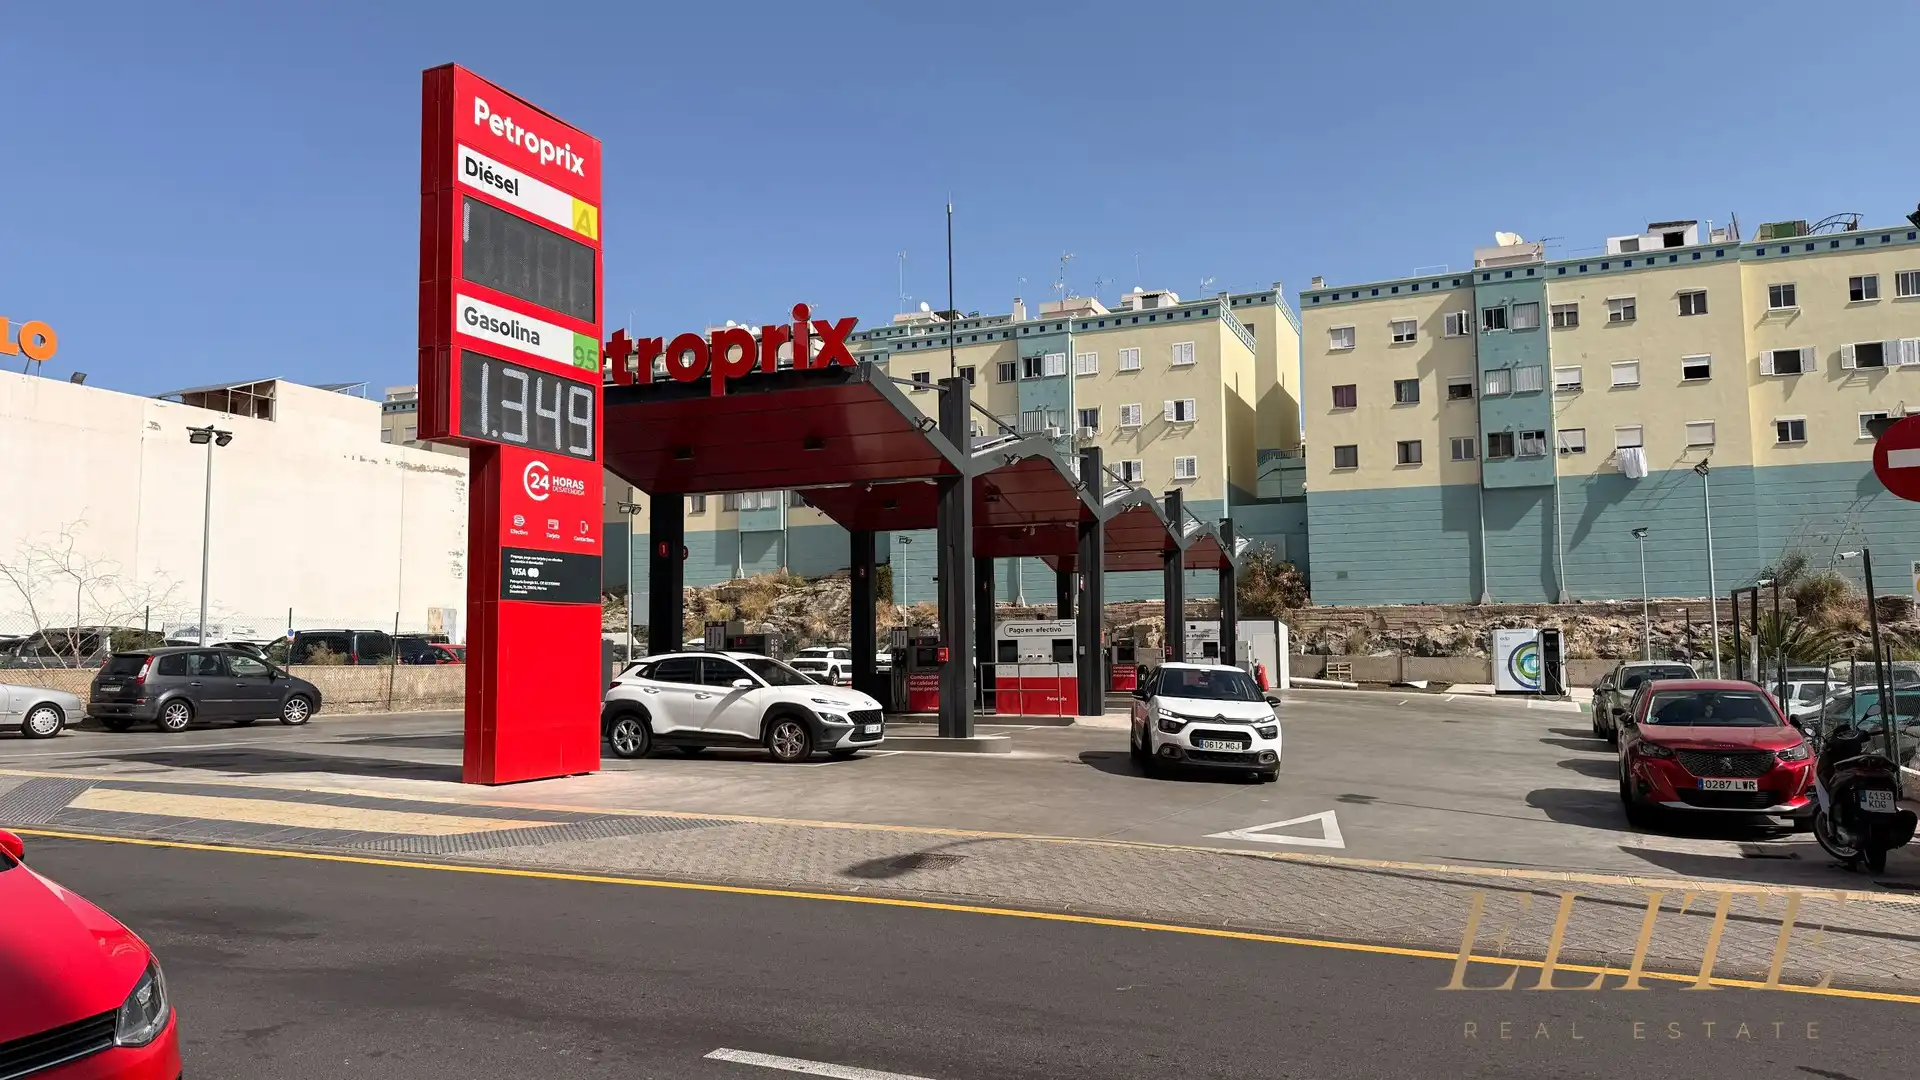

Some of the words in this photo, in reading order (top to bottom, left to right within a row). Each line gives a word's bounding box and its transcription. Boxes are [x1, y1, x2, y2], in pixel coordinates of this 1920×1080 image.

[474, 96, 585, 177] Petroprix
[465, 156, 519, 196] Diésel
[575, 208, 592, 237] A
[0, 316, 58, 361] LO
[464, 306, 541, 346] Gasolina
[573, 345, 598, 371] 95
[481, 362, 593, 457] 1.349
[530, 472, 550, 491] 24
[552, 475, 585, 490] HORAS
[510, 567, 527, 576] VISA
[1204, 740, 1224, 749] 0612
[1705, 779, 1732, 790] 0287
[1735, 780, 1756, 790] LWR
[1868, 791, 1892, 801] 4193
